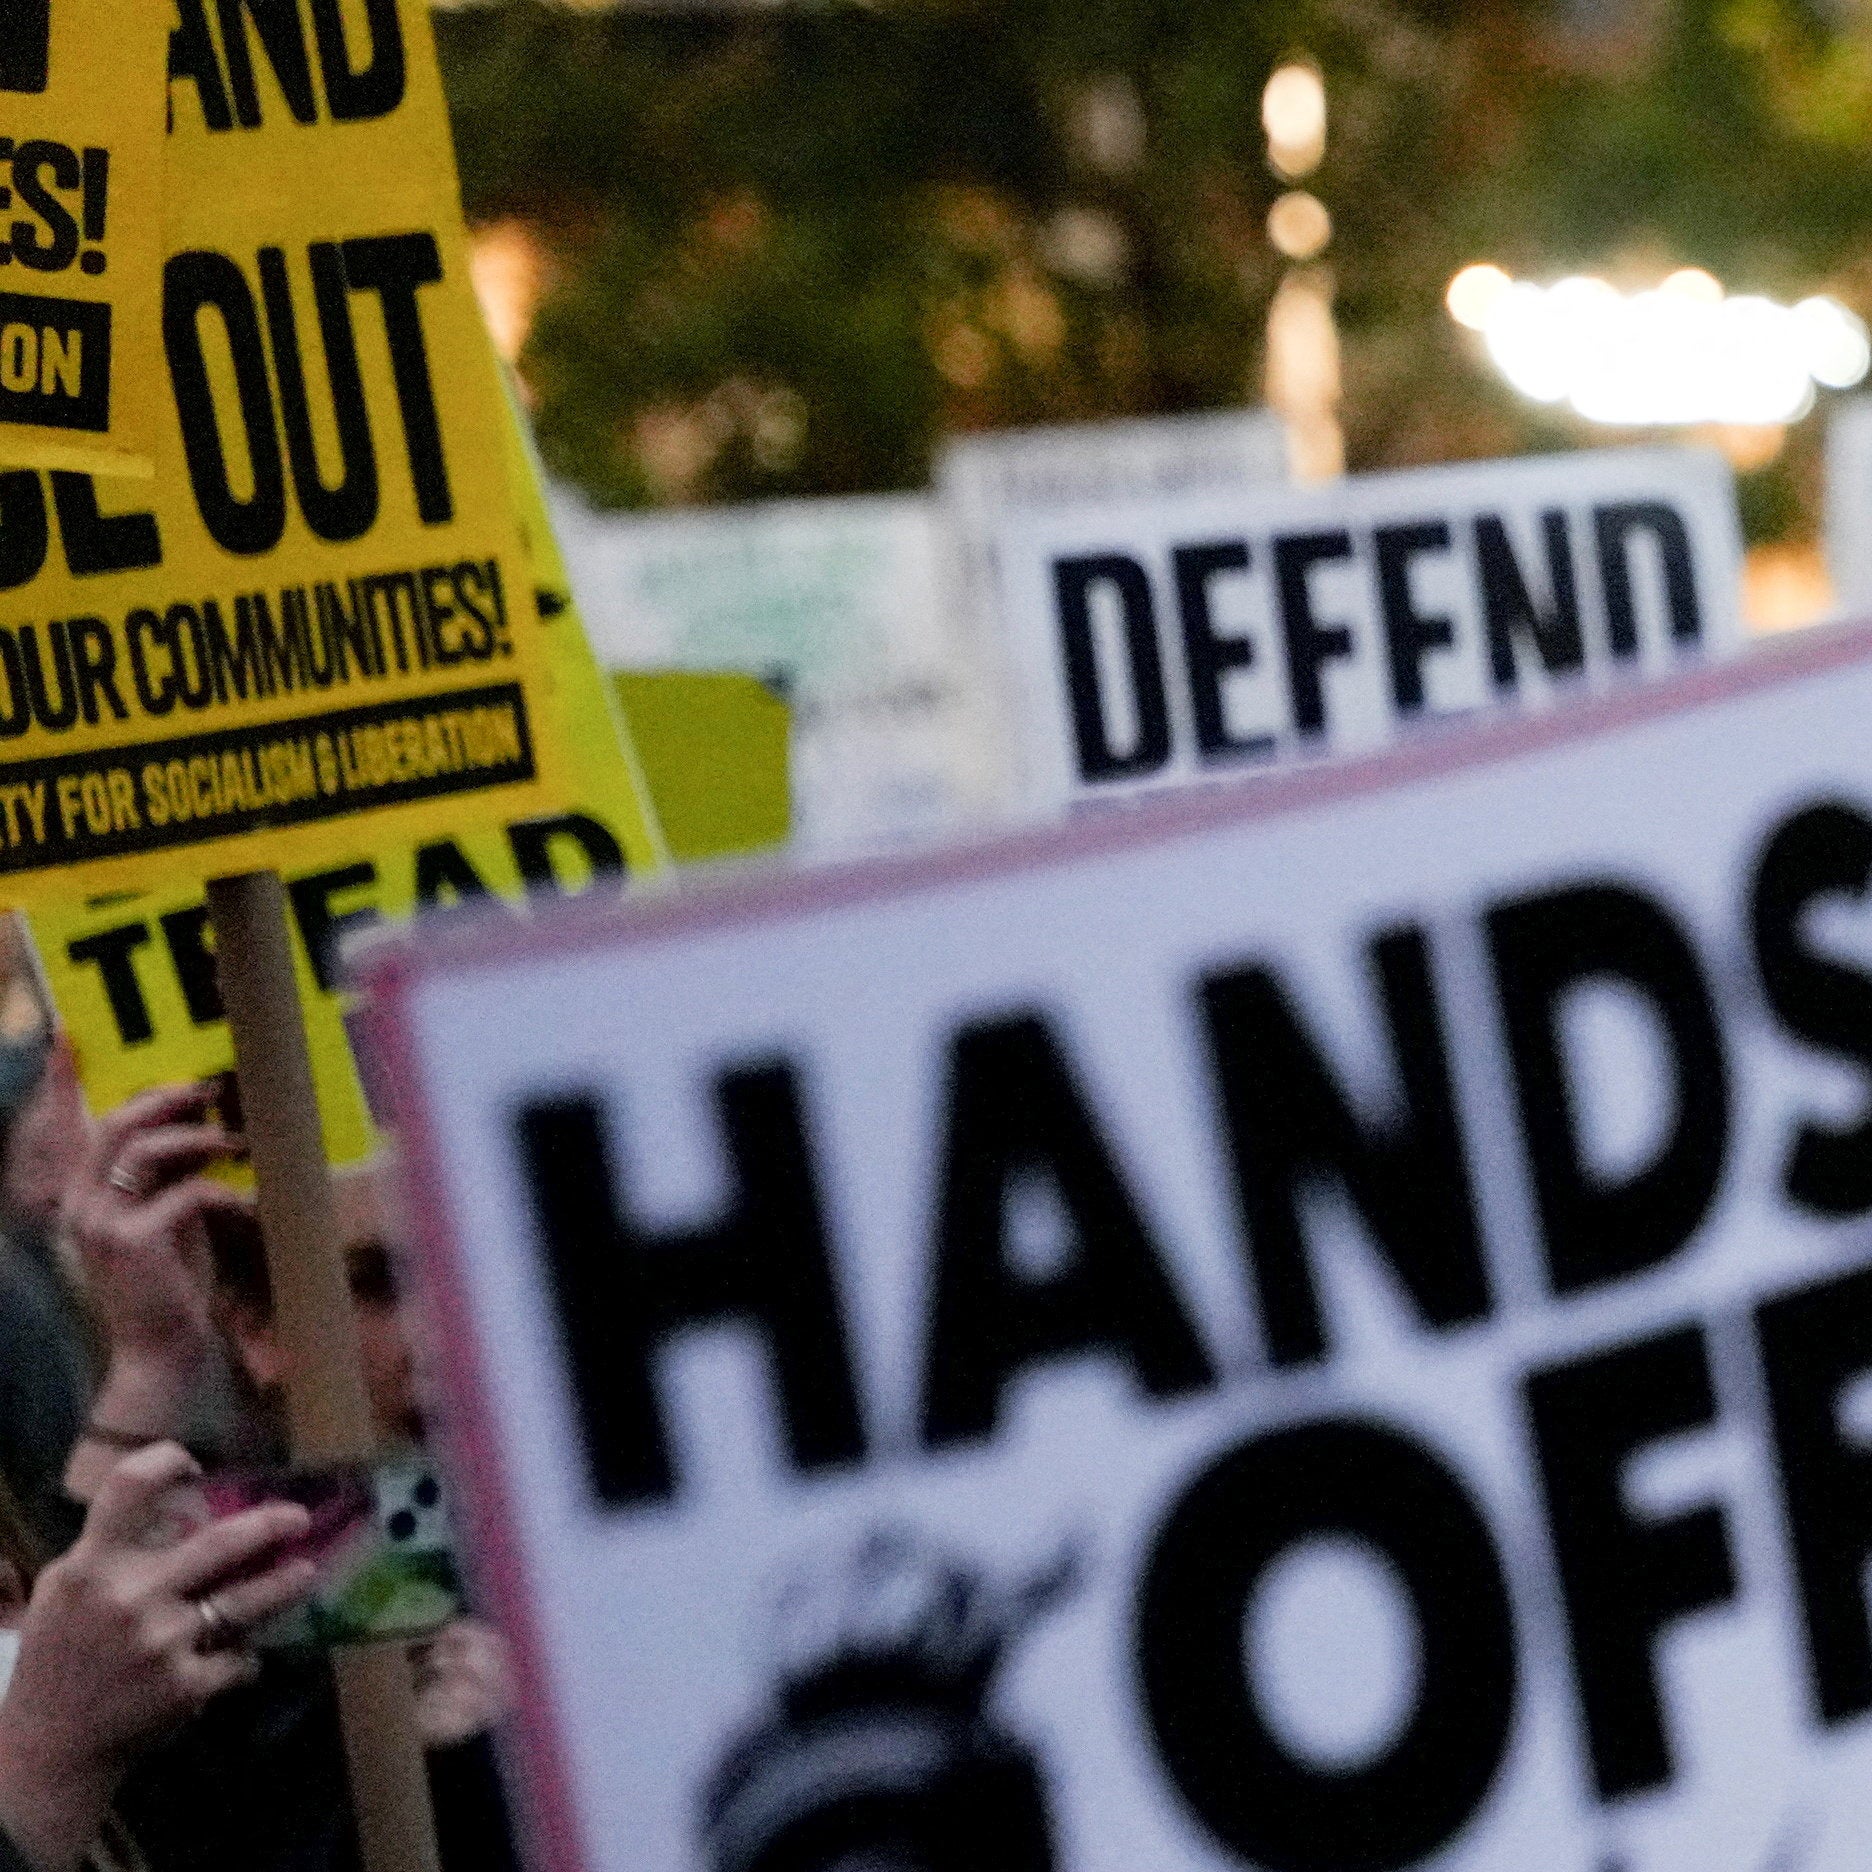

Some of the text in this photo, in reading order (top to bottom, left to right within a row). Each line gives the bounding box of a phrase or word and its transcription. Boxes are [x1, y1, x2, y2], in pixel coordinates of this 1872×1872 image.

[161, 232, 453, 556] OUT
[124, 558, 513, 717] COMMUNITIES!
[1050, 498, 1704, 784] DEFEND
[56, 766, 141, 840] FOR
[142, 733, 318, 827] SOCIALISM
[338, 702, 521, 791] LIBERATION
